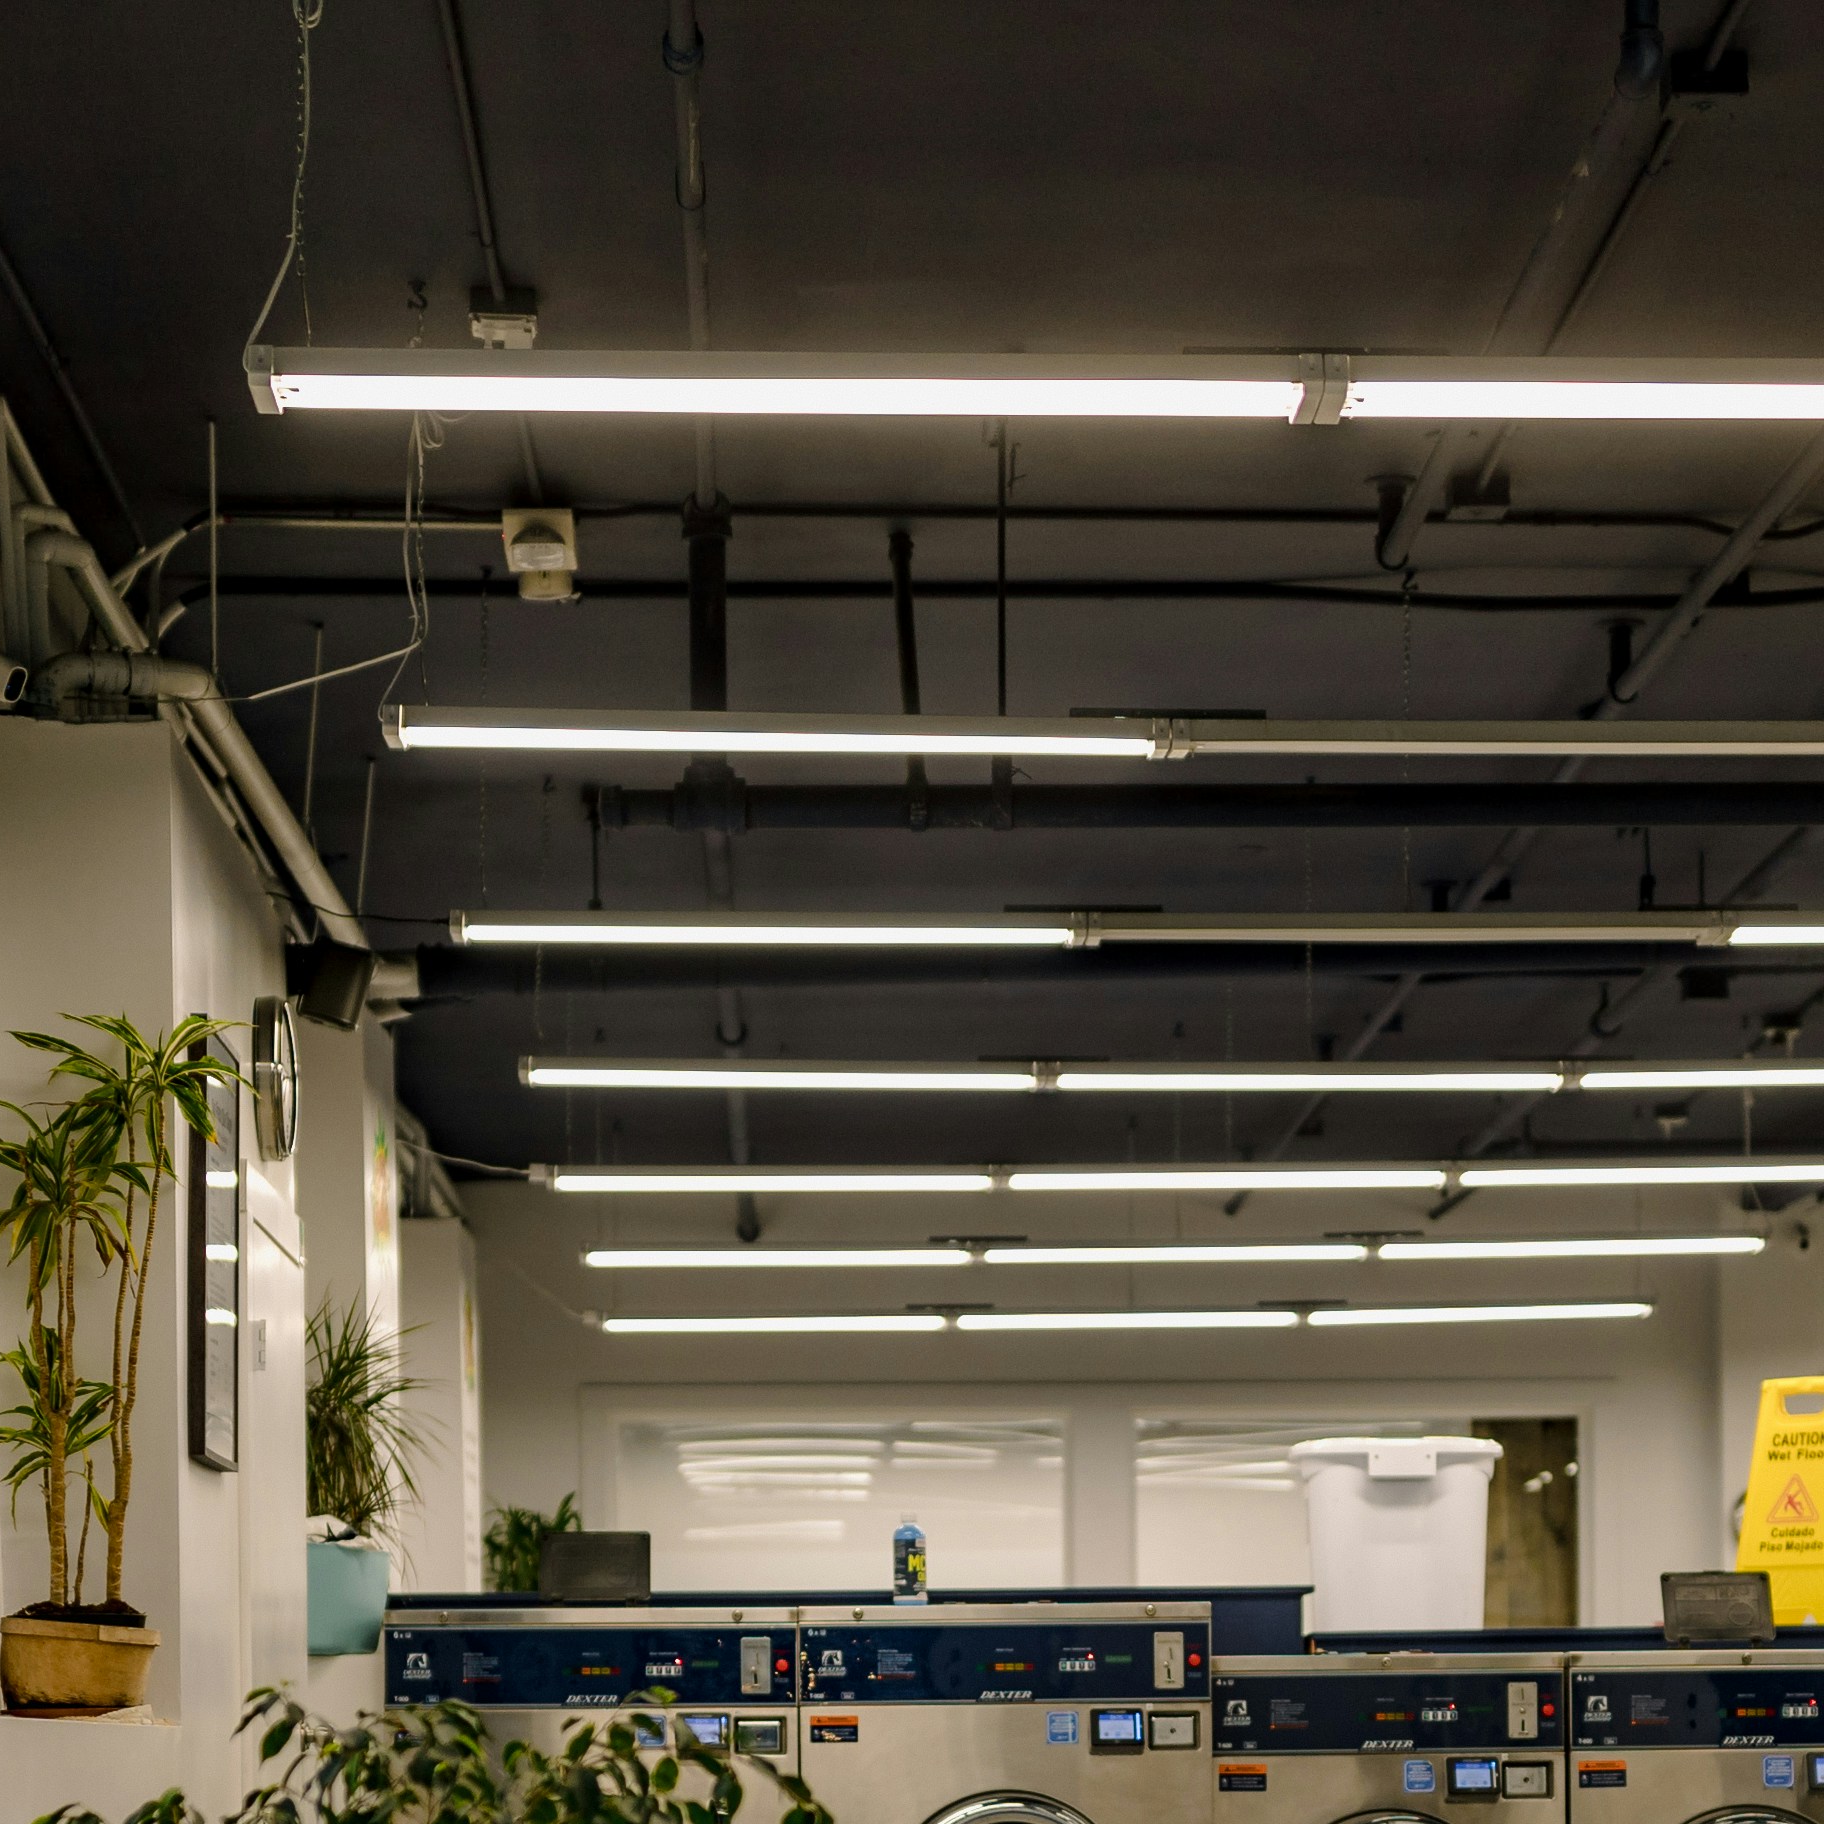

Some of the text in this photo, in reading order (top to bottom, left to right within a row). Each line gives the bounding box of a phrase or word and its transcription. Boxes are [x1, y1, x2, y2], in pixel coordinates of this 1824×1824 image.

[1767, 1450, 1791, 1461] Wet
[1770, 1527, 1815, 1538] Cuidado
[1759, 1540, 1824, 1553] Piso Mojado
[565, 1694, 619, 1703] DEXTER
[980, 1690, 1033, 1699] DEXTER
[1361, 1739, 1414, 1748] DEXTER
[1723, 1735, 1775, 1745] DEXTER
